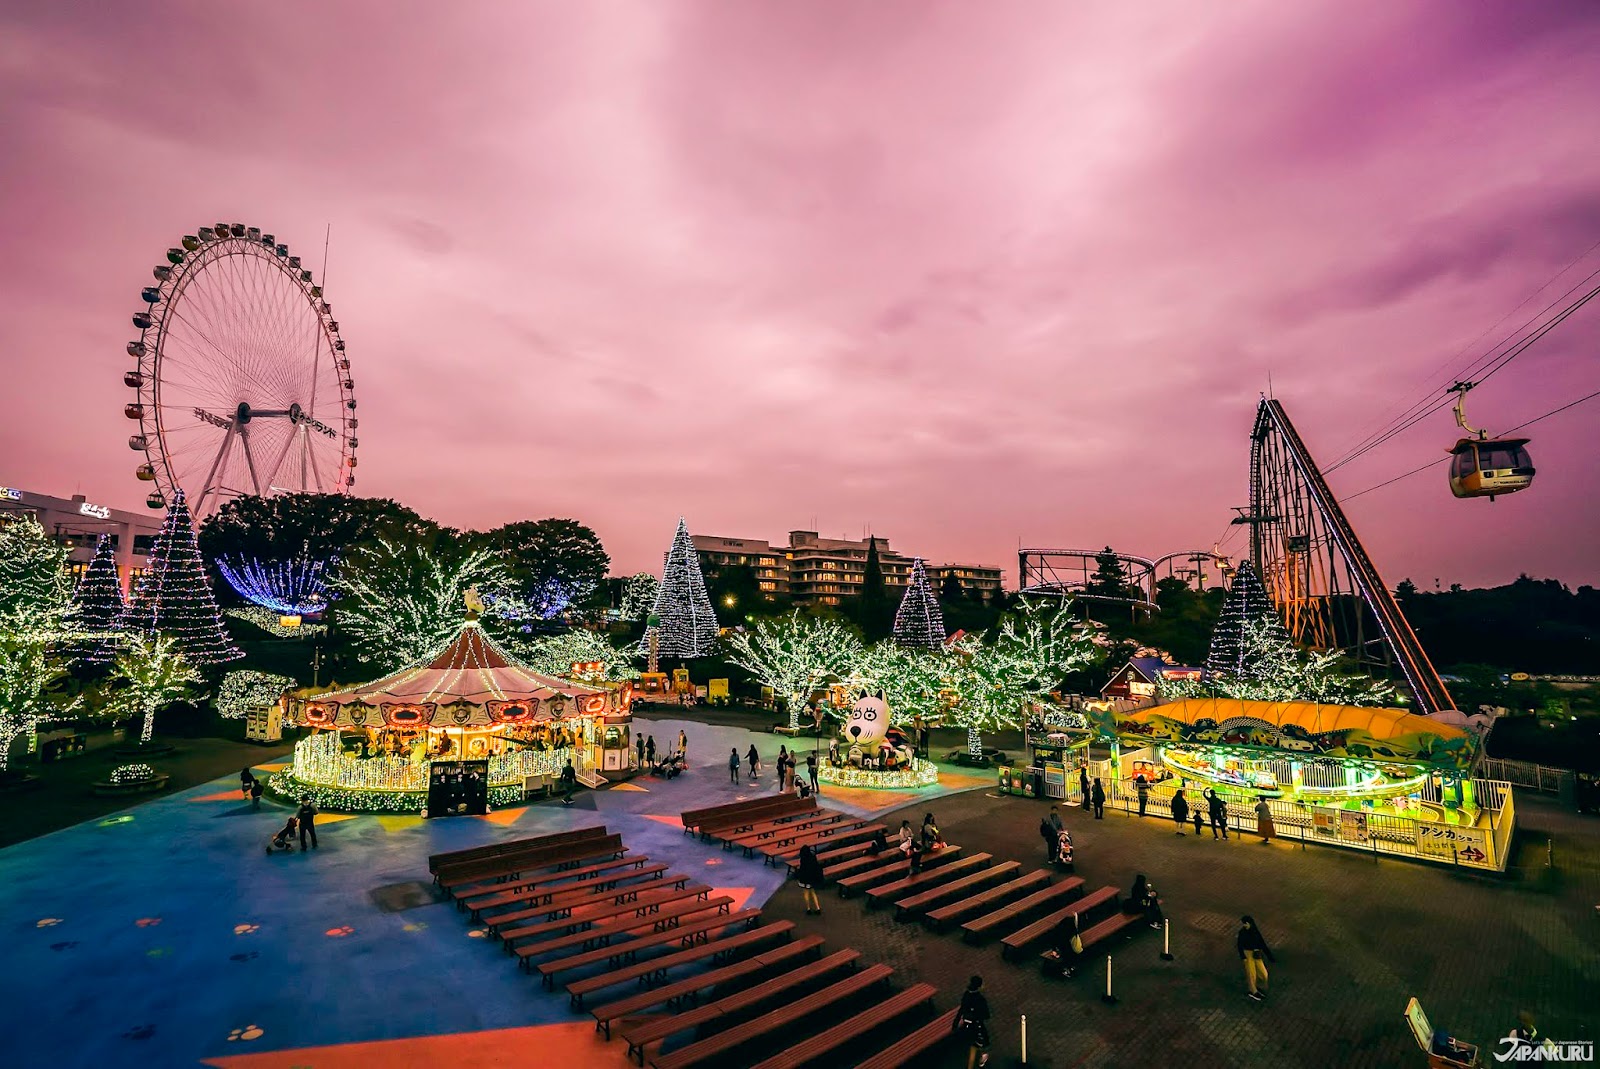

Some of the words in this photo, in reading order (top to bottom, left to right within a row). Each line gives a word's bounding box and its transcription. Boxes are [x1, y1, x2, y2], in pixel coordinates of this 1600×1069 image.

[1419, 826, 1484, 843] アシカショー
